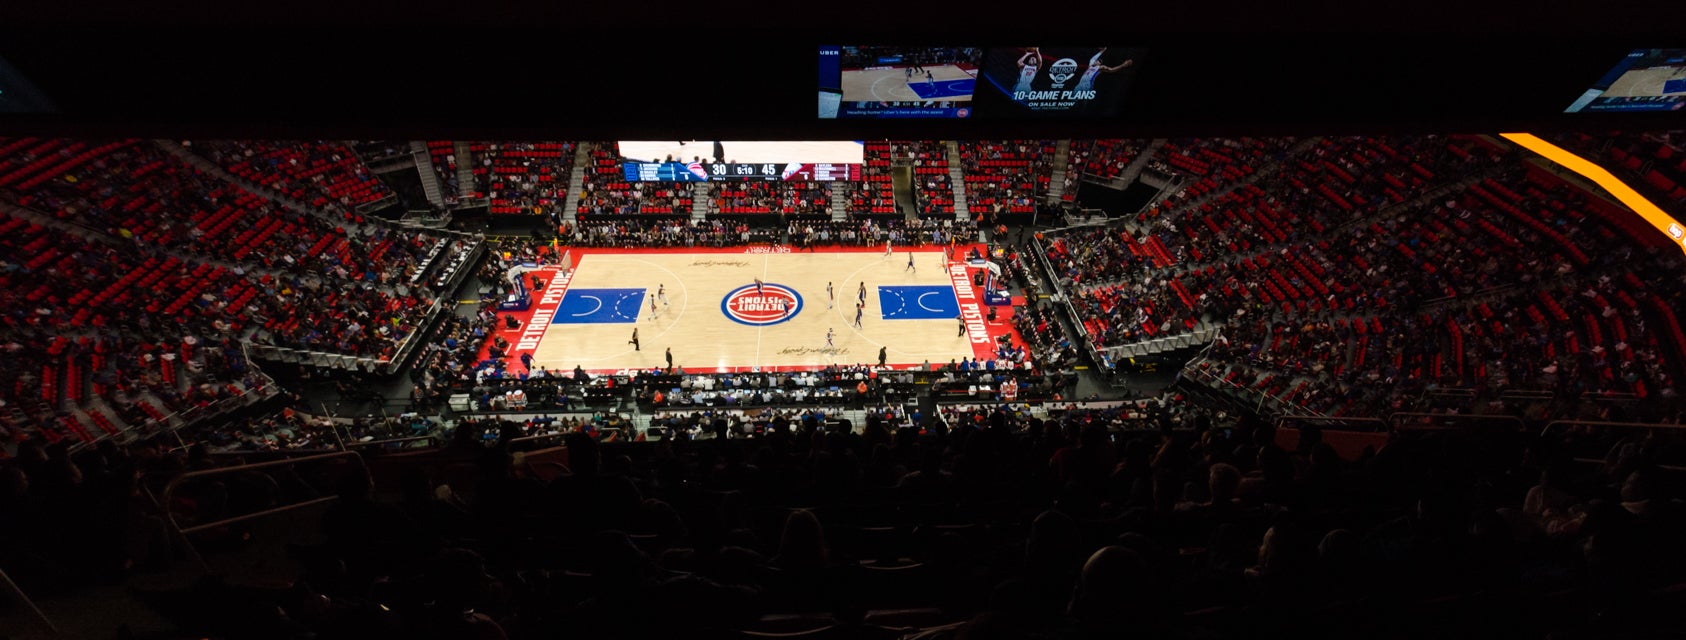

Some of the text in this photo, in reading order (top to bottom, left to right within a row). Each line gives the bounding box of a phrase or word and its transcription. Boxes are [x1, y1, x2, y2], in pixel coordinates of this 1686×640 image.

[1013, 90, 1097, 101] 10-GAME PLANS
[712, 164, 726, 175] 30
[737, 167, 753, 175] 5:10
[762, 164, 776, 175] 45
[950, 264, 975, 299] DETROIT
[738, 296, 784, 304] PISTONS
[738, 304, 784, 312] DETROIT
[961, 303, 990, 344] PISTONS
[516, 308, 554, 351] DETROIT
